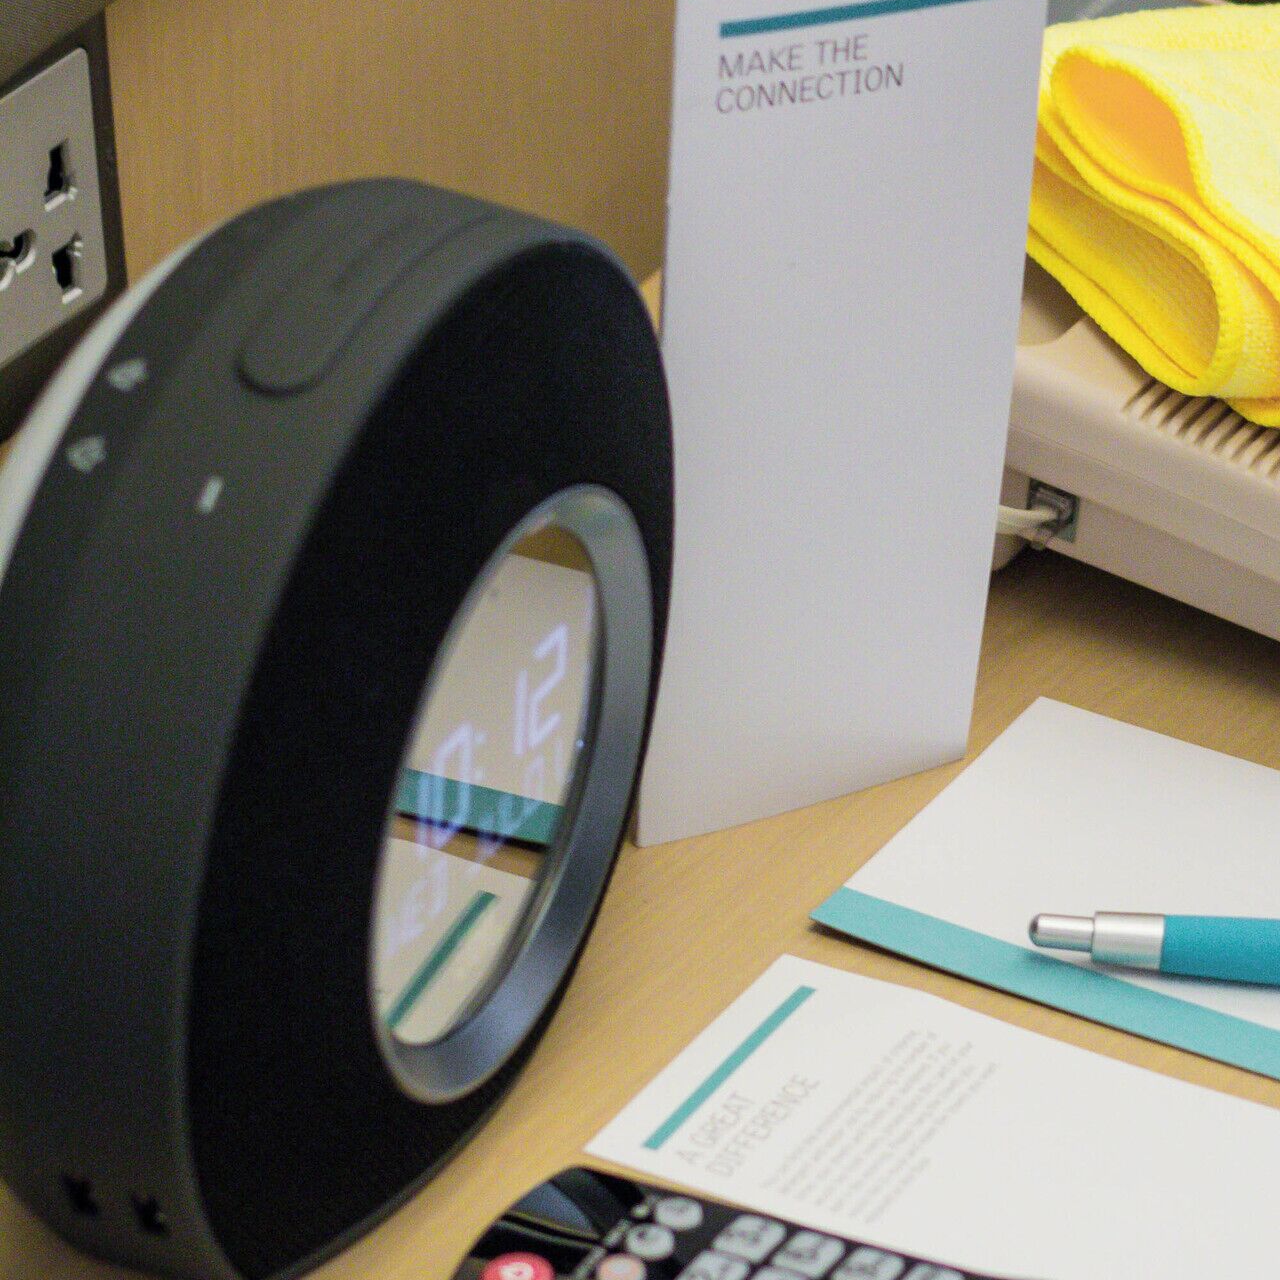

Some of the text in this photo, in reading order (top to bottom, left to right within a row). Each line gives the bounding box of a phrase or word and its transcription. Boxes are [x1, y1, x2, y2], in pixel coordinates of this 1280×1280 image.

[718, 34, 868, 80] MAKE THE
[715, 64, 904, 115] CONNECTION
[689, 1091, 757, 1147] GREAT
[707, 1074, 820, 1178] DIFFERENCE
